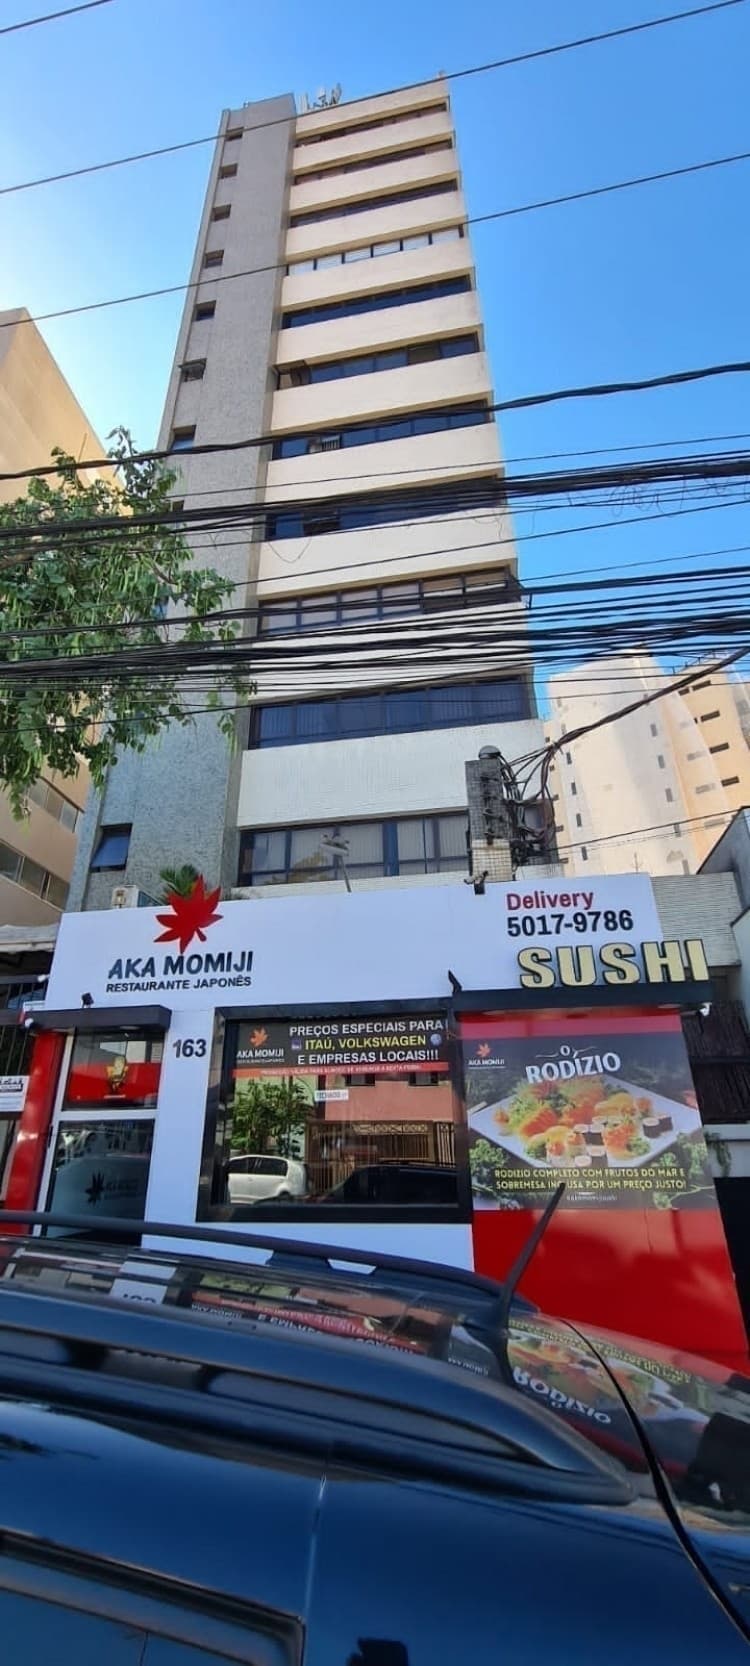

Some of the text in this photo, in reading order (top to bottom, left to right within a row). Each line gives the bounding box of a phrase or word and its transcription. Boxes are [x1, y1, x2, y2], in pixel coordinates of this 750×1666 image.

[506, 891, 594, 911] Delivery
[507, 910, 634, 937] 5017-9786
[108, 951, 254, 979] AKA MOMIJI
[517, 939, 710, 989] SUSHI
[106, 974, 252, 993] RESTAURANTE JAPONÊS
[289, 1020, 443, 1037] PREÇOS ESPECIAIS PARA
[173, 1038, 207, 1058] 163
[305, 1035, 426, 1050] ITAÚ, VOLKSWAGEN
[560, 1045, 570, 1056] O
[236, 1048, 284, 1058] AKA MOMIJI
[297, 1049, 439, 1065] E EMPRESAS LOCAIS!!!
[525, 1050, 621, 1084] RODÍZIO
[533, 1168, 580, 1178] COMPLETO
[582, 1168, 602, 1177] COM
[605, 1168, 639, 1177] FRUTOS
[641, 1168, 655, 1177] DO
[658, 1168, 678, 1177] MAR
[680, 1168, 686, 1177] E
[496, 1181, 546, 1189] SOBREMESA
[586, 1180, 604, 1189] POR
[607, 1180, 620, 1189] UM
[623, 1180, 653, 1191] PREÇO
